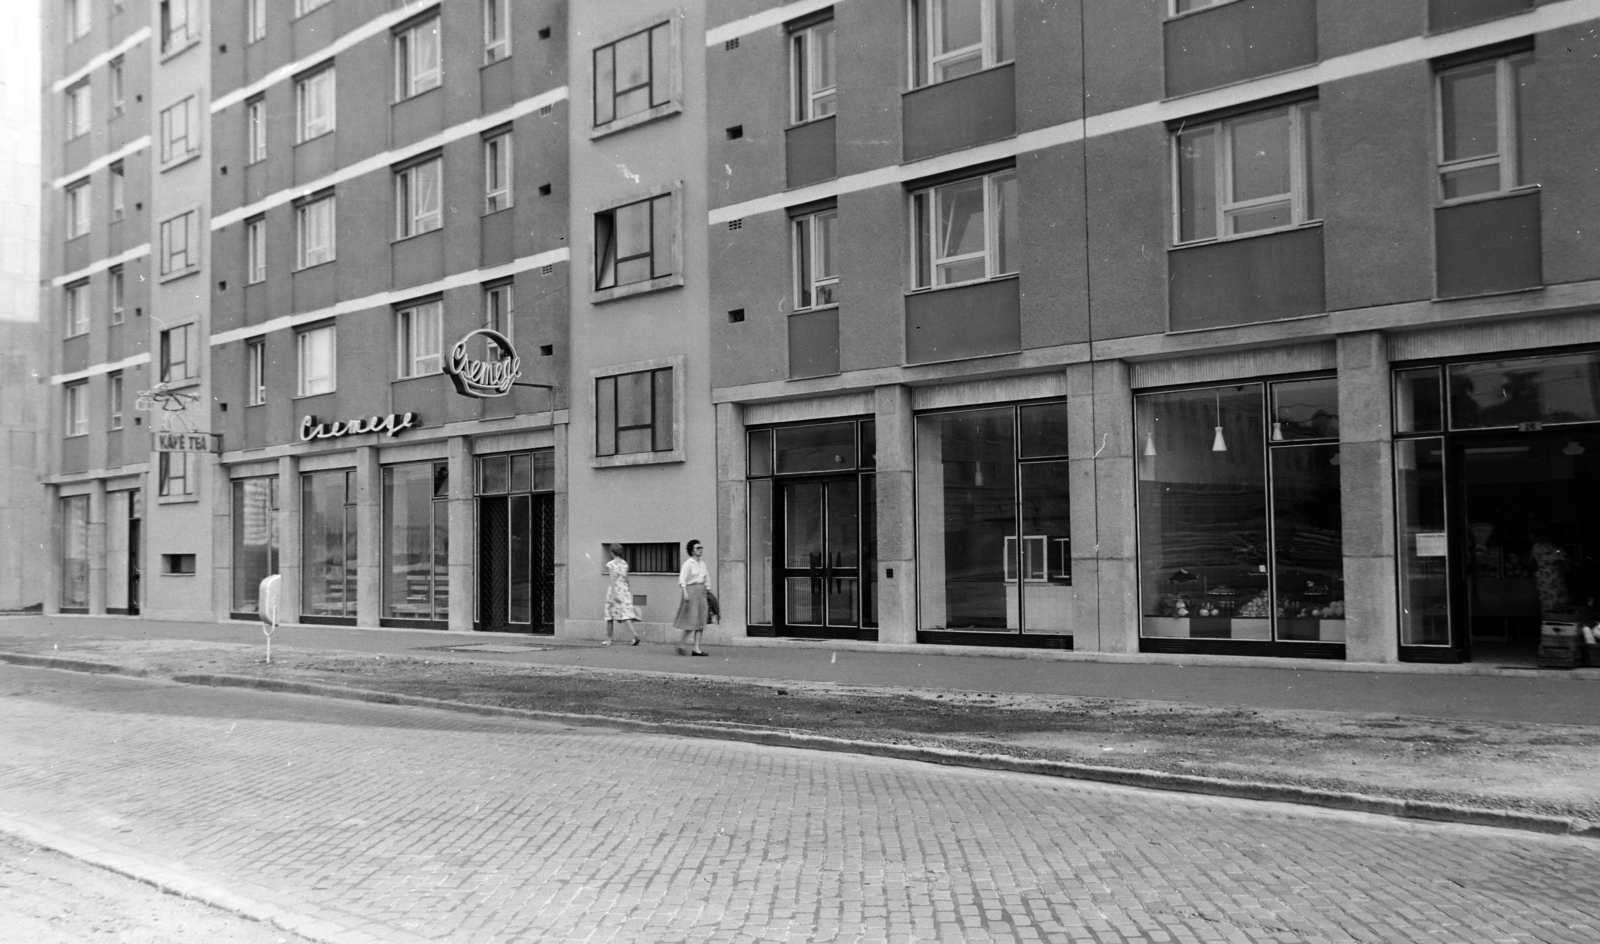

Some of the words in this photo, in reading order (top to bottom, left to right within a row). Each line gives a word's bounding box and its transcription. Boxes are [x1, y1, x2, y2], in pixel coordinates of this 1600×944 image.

[451, 341, 522, 391] Csemege
[300, 412, 414, 441] Csemege
[188, 435, 207, 451] TEA
